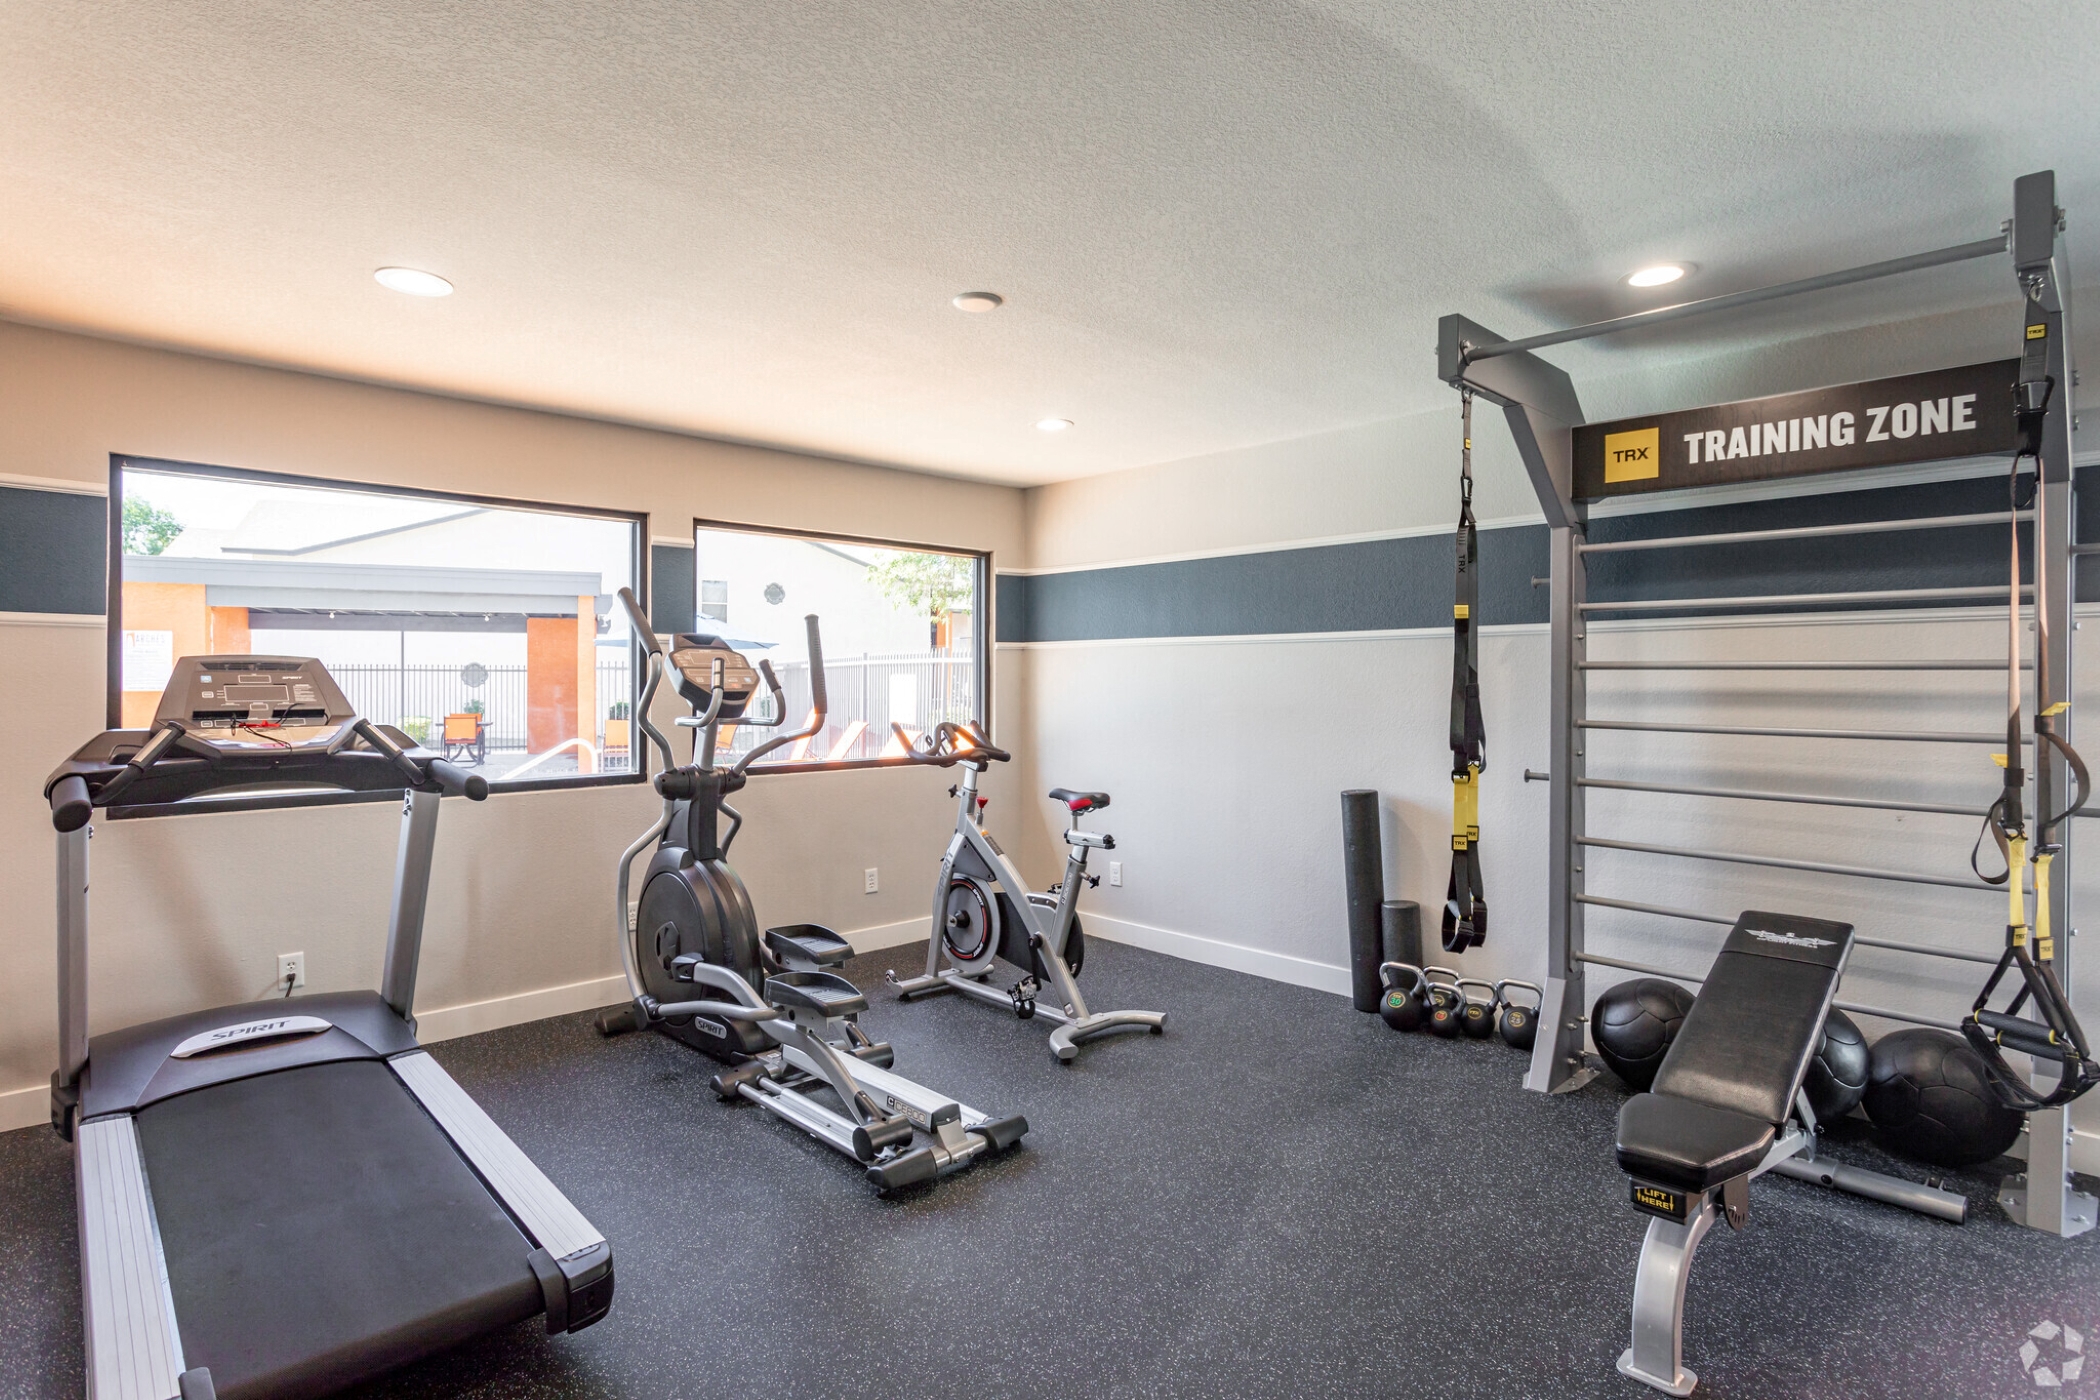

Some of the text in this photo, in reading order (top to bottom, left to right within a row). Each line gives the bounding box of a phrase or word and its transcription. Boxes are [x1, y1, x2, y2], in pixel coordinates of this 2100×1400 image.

[1684, 394, 1977, 464] TRAINING ZONE
[1613, 447, 1649, 463] TRX
[1458, 554, 1466, 573] TRX
[211, 1020, 291, 1041] SPIRIT
[697, 1020, 723, 1036] SPIRIT
[1644, 1187, 1667, 1200] LIFT
